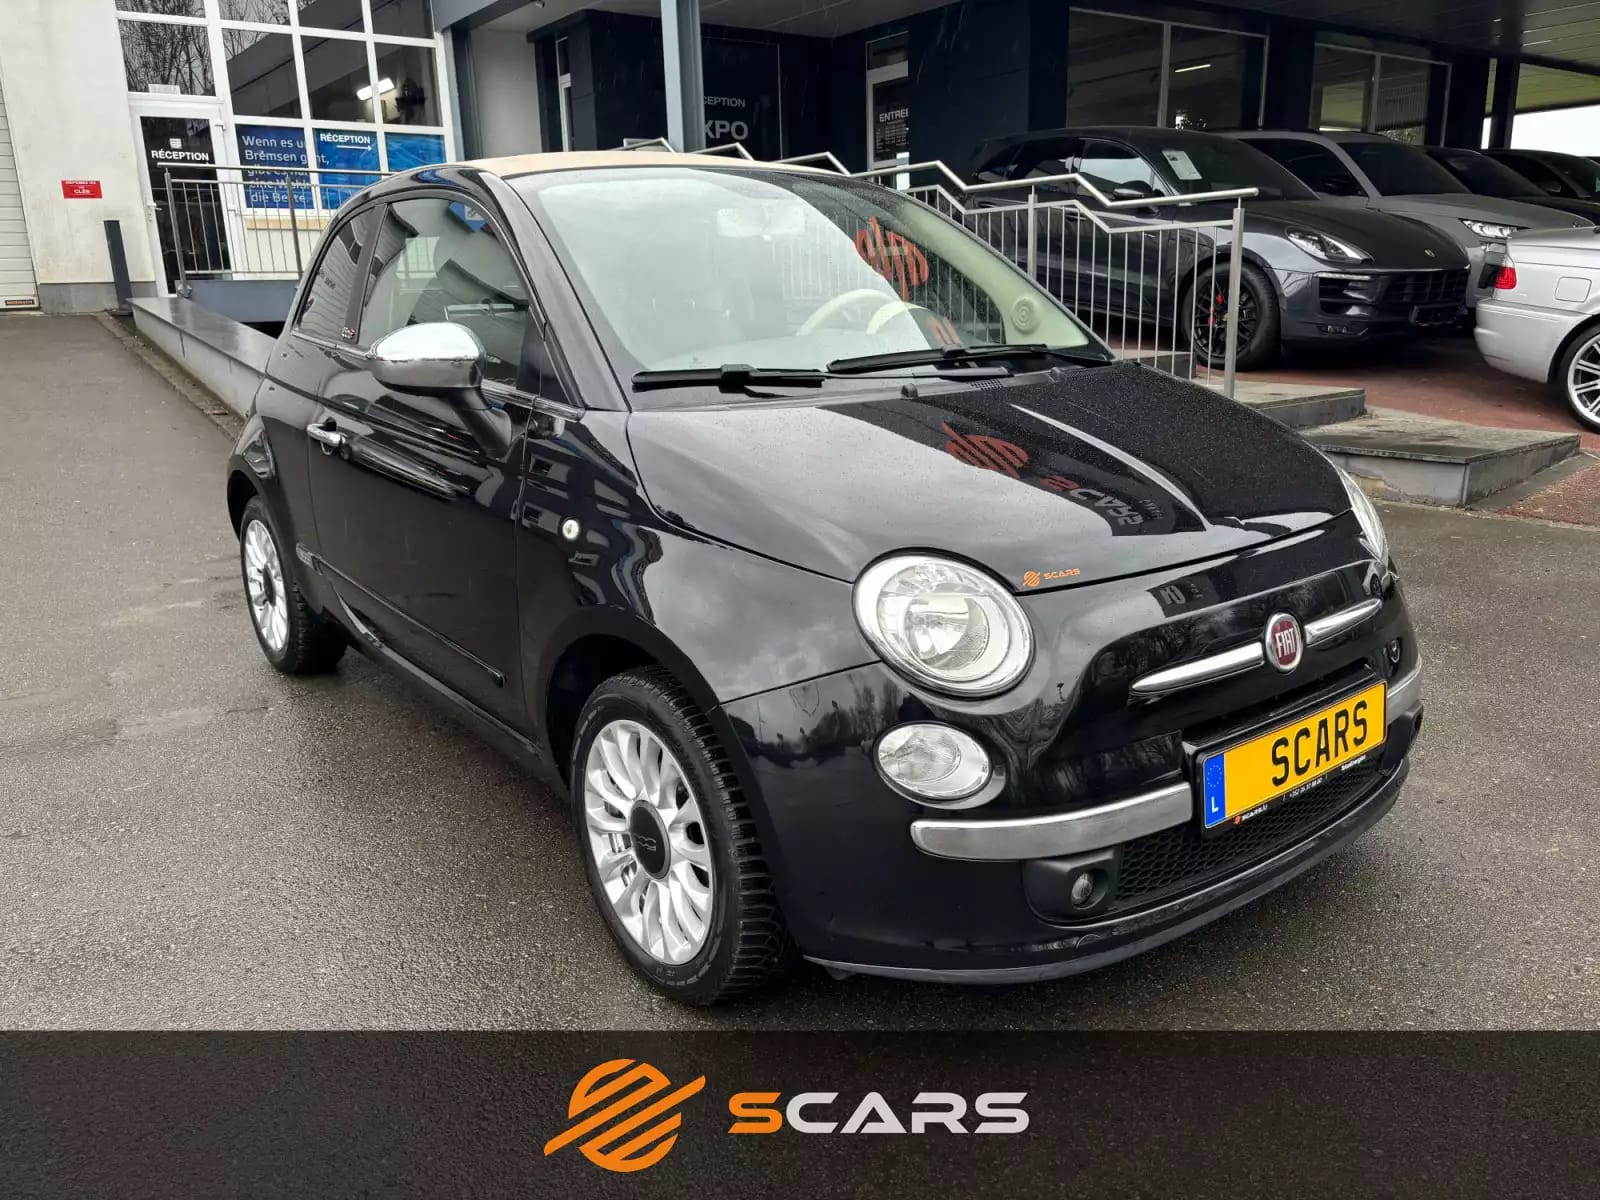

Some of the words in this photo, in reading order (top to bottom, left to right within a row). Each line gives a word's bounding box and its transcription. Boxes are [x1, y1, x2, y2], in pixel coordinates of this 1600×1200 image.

[704, 95, 746, 107] EPTION
[704, 119, 749, 140] XPO
[241, 135, 277, 148] Wenn
[280, 139, 294, 148] es
[296, 139, 305, 148] u
[320, 131, 371, 144] RÉCEPTION
[151, 147, 209, 161] RÉCEPTION
[1043, 568, 1081, 579] SCARS
[1275, 628, 1296, 658] FIAT
[1271, 700, 1367, 786] SCARS
[1211, 796, 1219, 813] L
